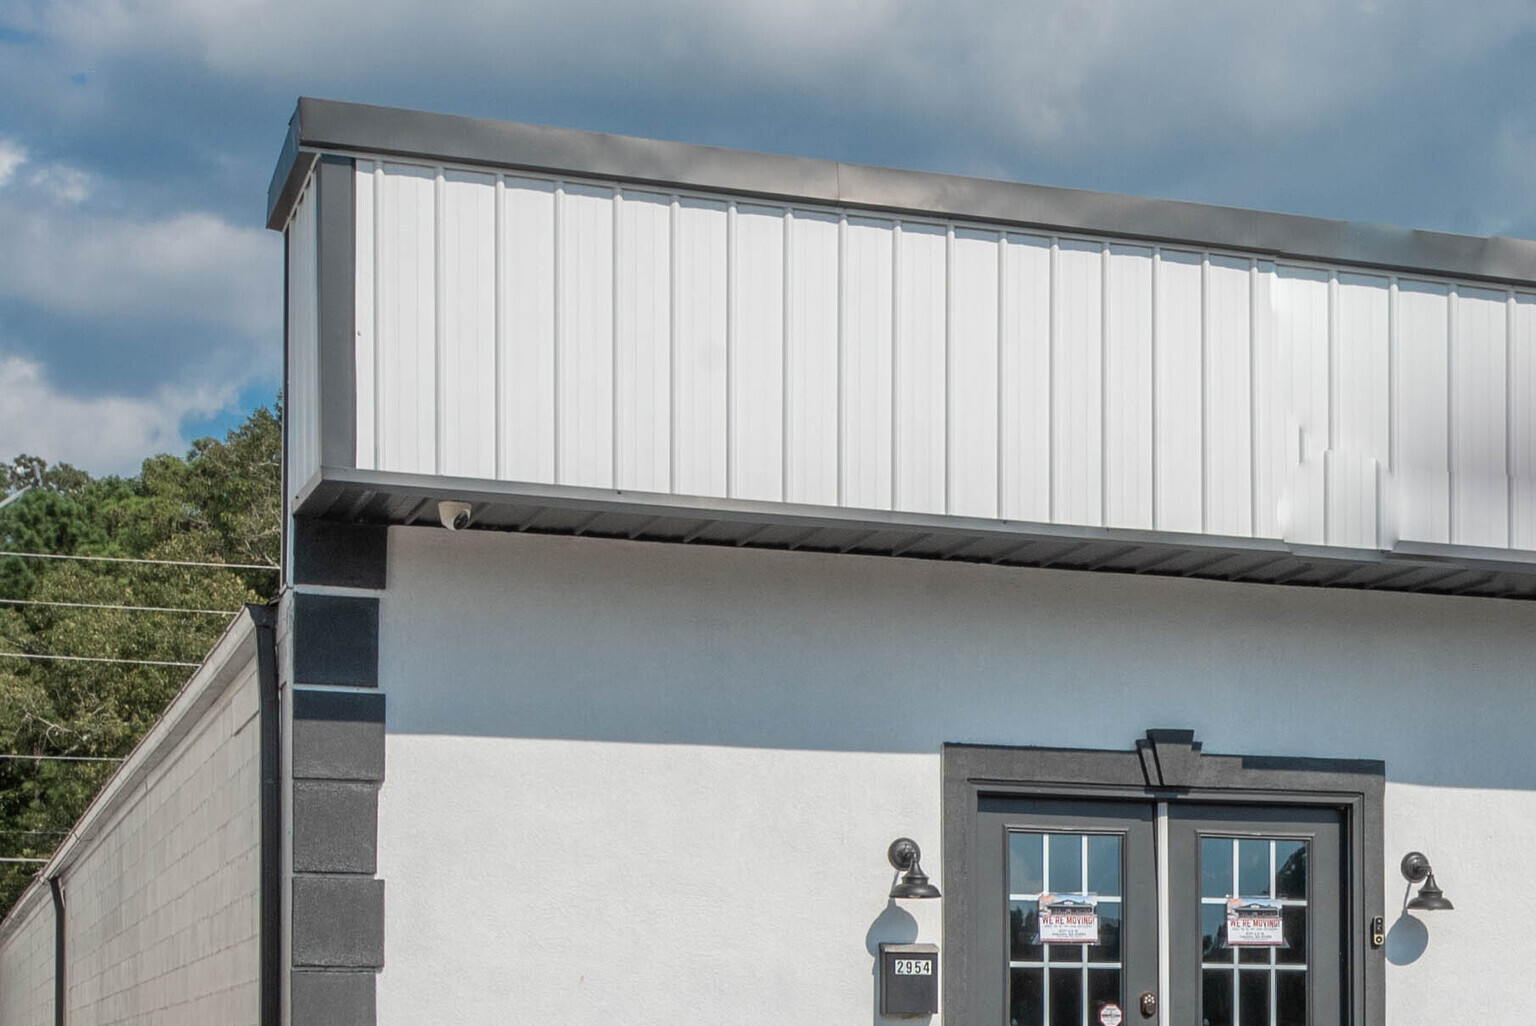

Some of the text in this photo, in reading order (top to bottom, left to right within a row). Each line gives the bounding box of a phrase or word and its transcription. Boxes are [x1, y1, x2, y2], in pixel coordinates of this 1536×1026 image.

[1043, 915, 1095, 925] WE'RE MOVING!
[1253, 919, 1280, 928] MOVING!
[897, 961, 930, 973] 2954
